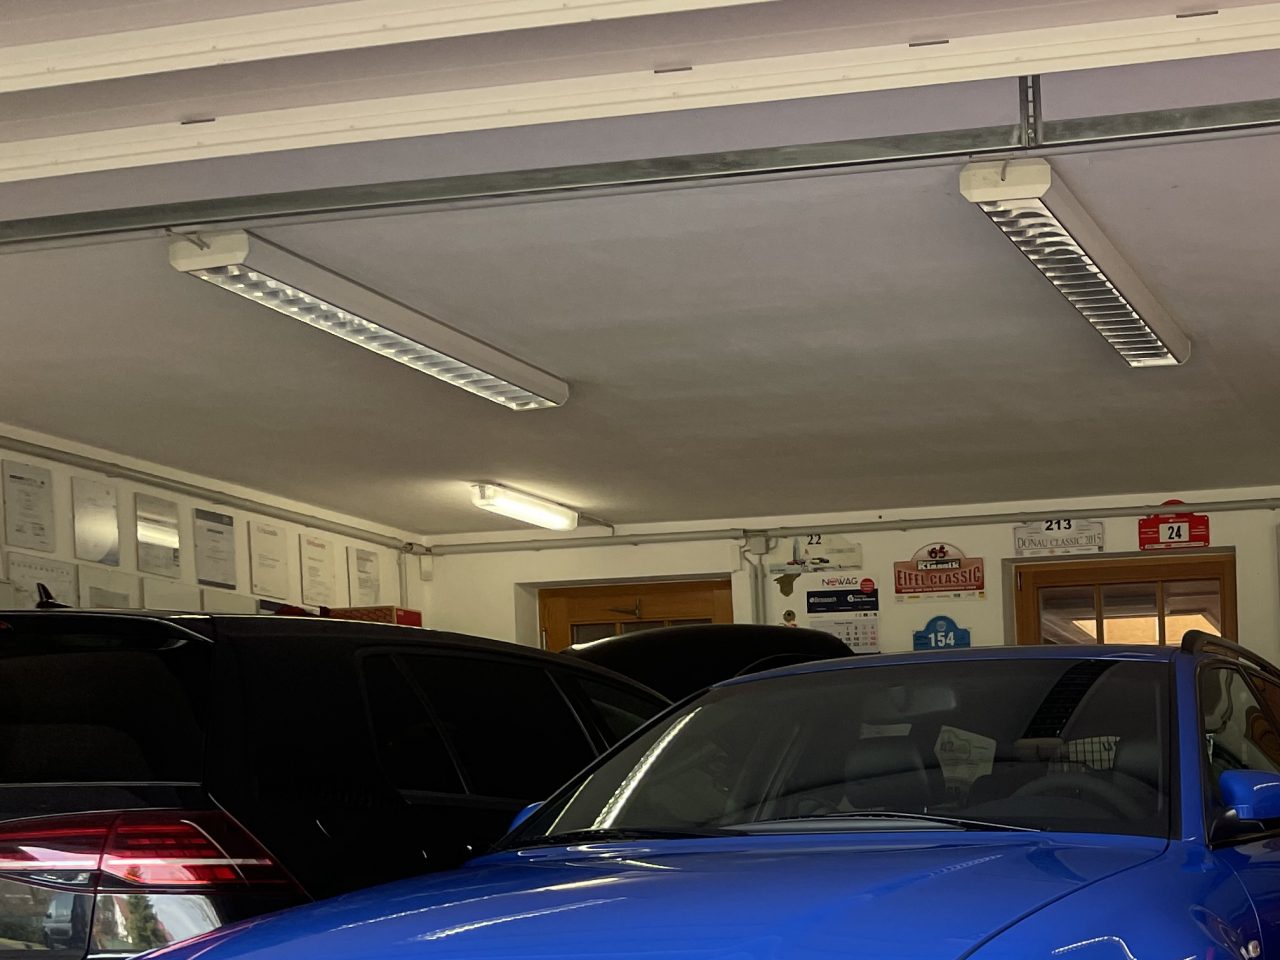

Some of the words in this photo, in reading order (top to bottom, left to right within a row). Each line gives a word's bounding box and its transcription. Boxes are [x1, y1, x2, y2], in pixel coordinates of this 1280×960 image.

[1045, 519, 1072, 531] 213
[807, 534, 822, 545] 22
[1168, 525, 1182, 540] 24
[1017, 537, 1048, 549] DONAU
[1050, 535, 1083, 547] CLASSIC
[897, 570, 926, 586] EIFEL
[930, 566, 980, 586] CLASSIC
[928, 632, 955, 647] 154
